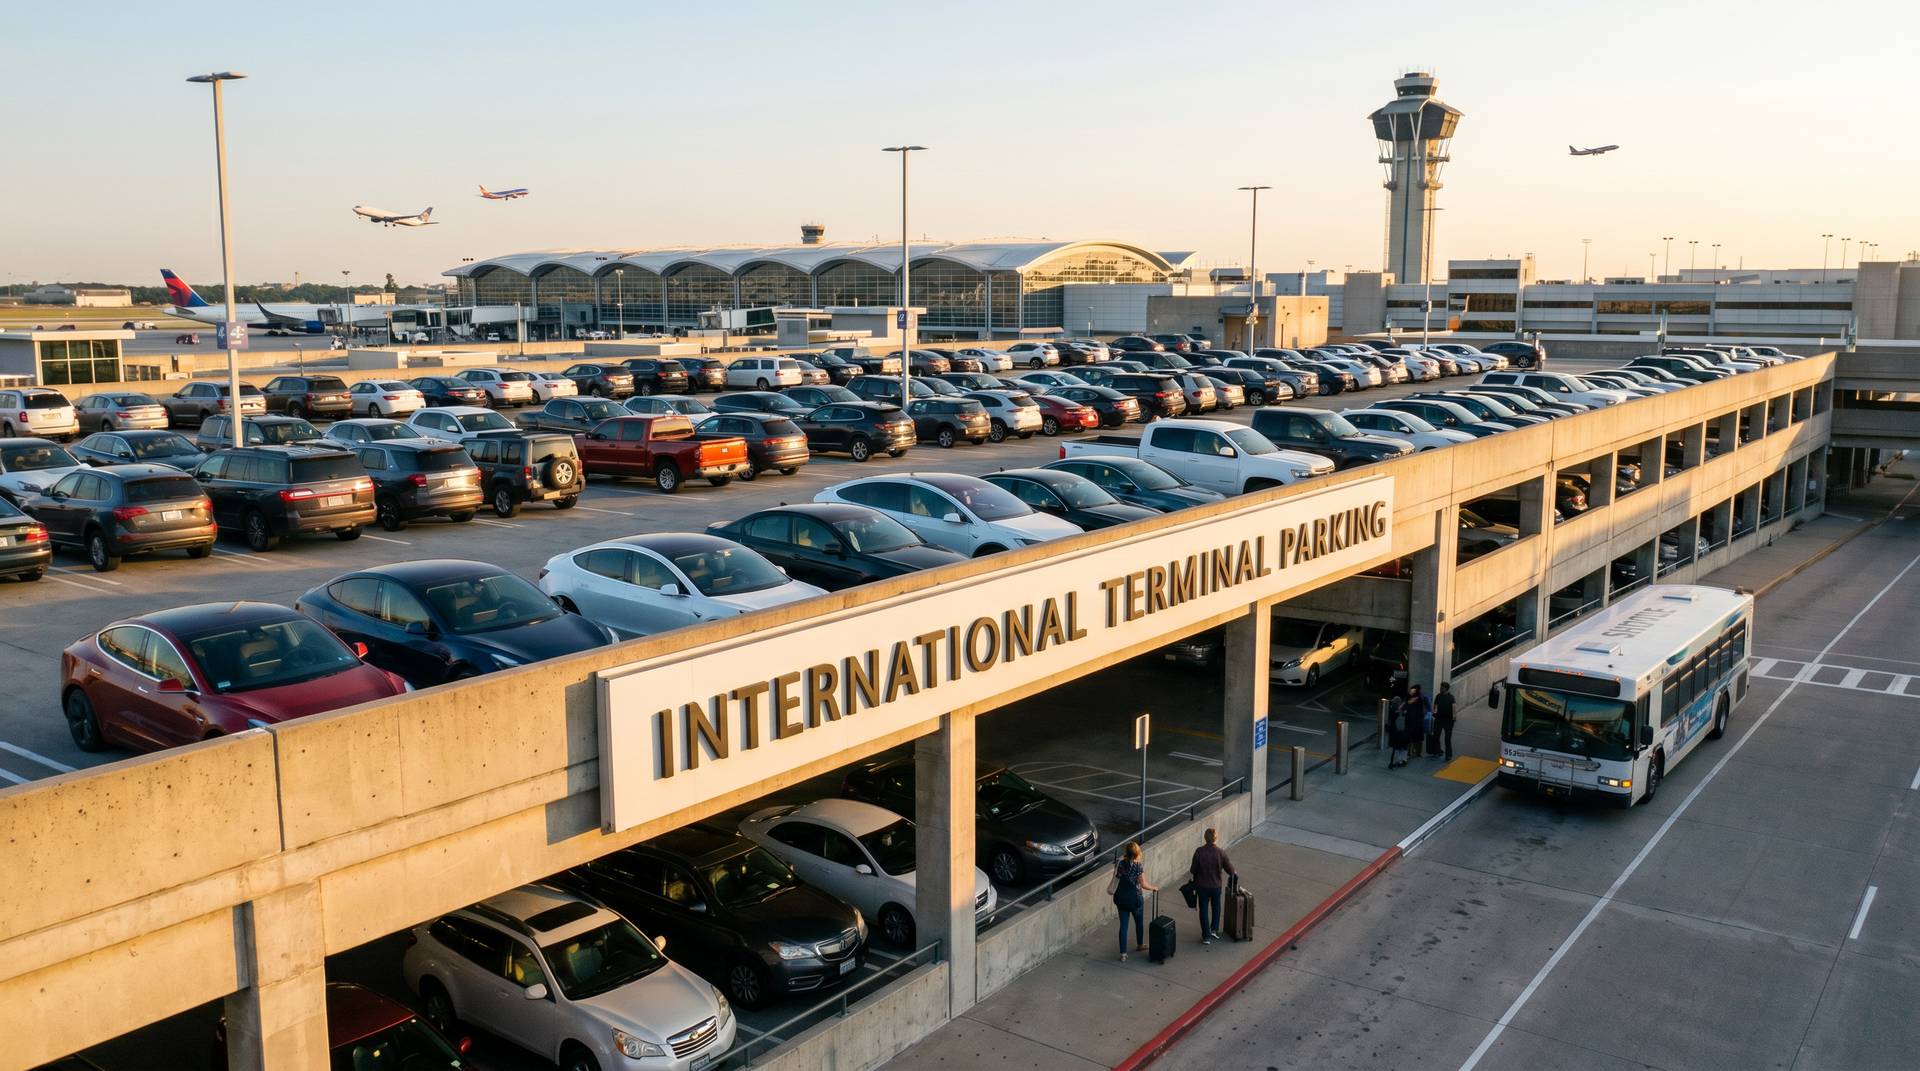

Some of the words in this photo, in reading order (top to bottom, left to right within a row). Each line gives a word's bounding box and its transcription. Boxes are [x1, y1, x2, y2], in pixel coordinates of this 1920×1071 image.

[657, 591, 1087, 779] INTERNATIONAL
[1099, 536, 1271, 628] TERMINAL
[1280, 501, 1386, 569] PARKING
